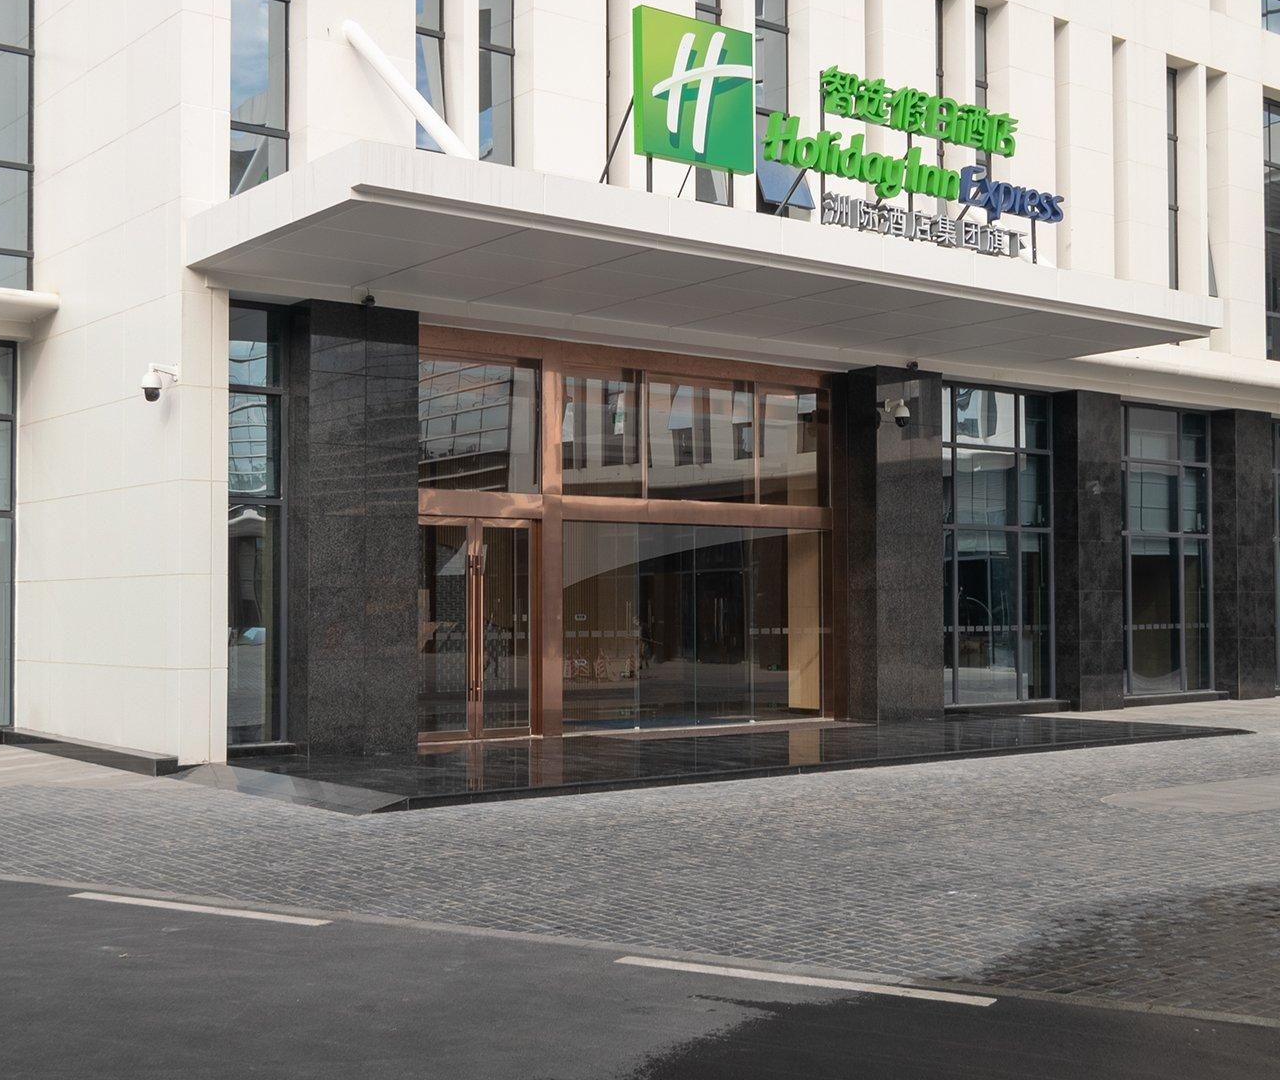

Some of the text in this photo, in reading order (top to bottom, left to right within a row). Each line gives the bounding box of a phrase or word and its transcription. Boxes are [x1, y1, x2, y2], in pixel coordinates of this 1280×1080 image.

[820, 65, 1018, 158] 智选假日酒店
[763, 111, 1064, 224] Holiday Inn Express
[822, 190, 1028, 258] 洲际酒店集团旗下
